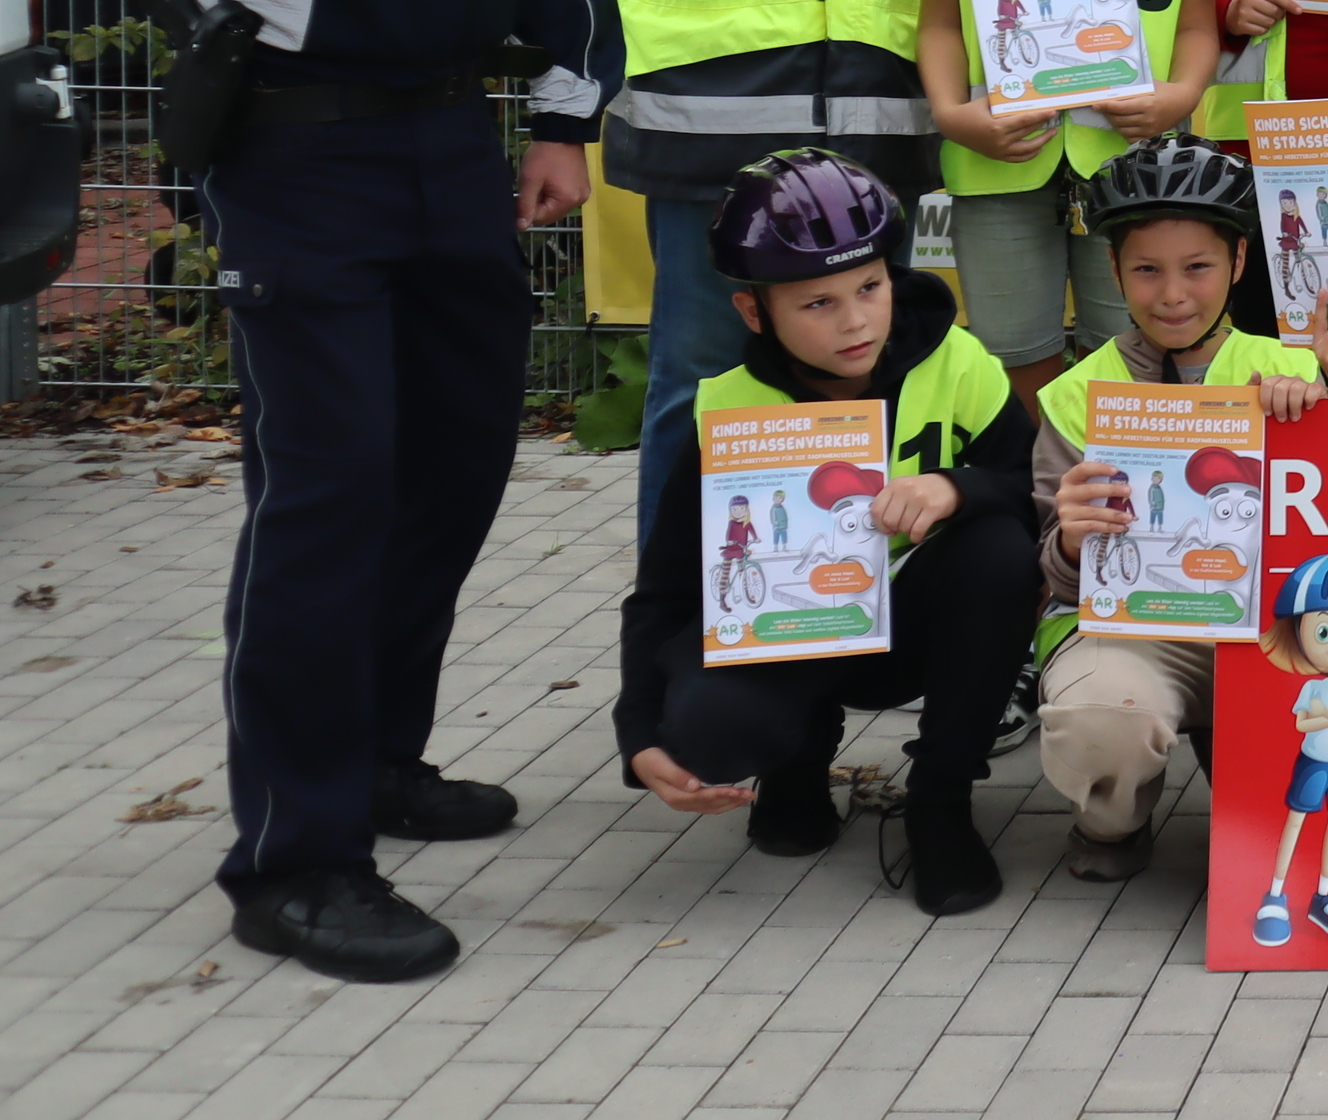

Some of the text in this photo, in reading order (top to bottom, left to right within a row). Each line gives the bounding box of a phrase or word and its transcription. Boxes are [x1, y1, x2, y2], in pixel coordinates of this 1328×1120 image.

[1004, 81, 1021, 92] AR
[1253, 117, 1296, 132] KINDER
[1256, 136, 1270, 149] IM
[1288, 311, 1306, 323] AR
[1096, 396, 1193, 414] KINDER SICHER
[711, 417, 812, 438] KINDER SICHER
[1095, 414, 1251, 433] IM STRASSENVERKEHR
[712, 432, 870, 456] IM STRASSENVERKEHR
[1094, 597, 1113, 609] AR
[719, 624, 739, 635] AR
